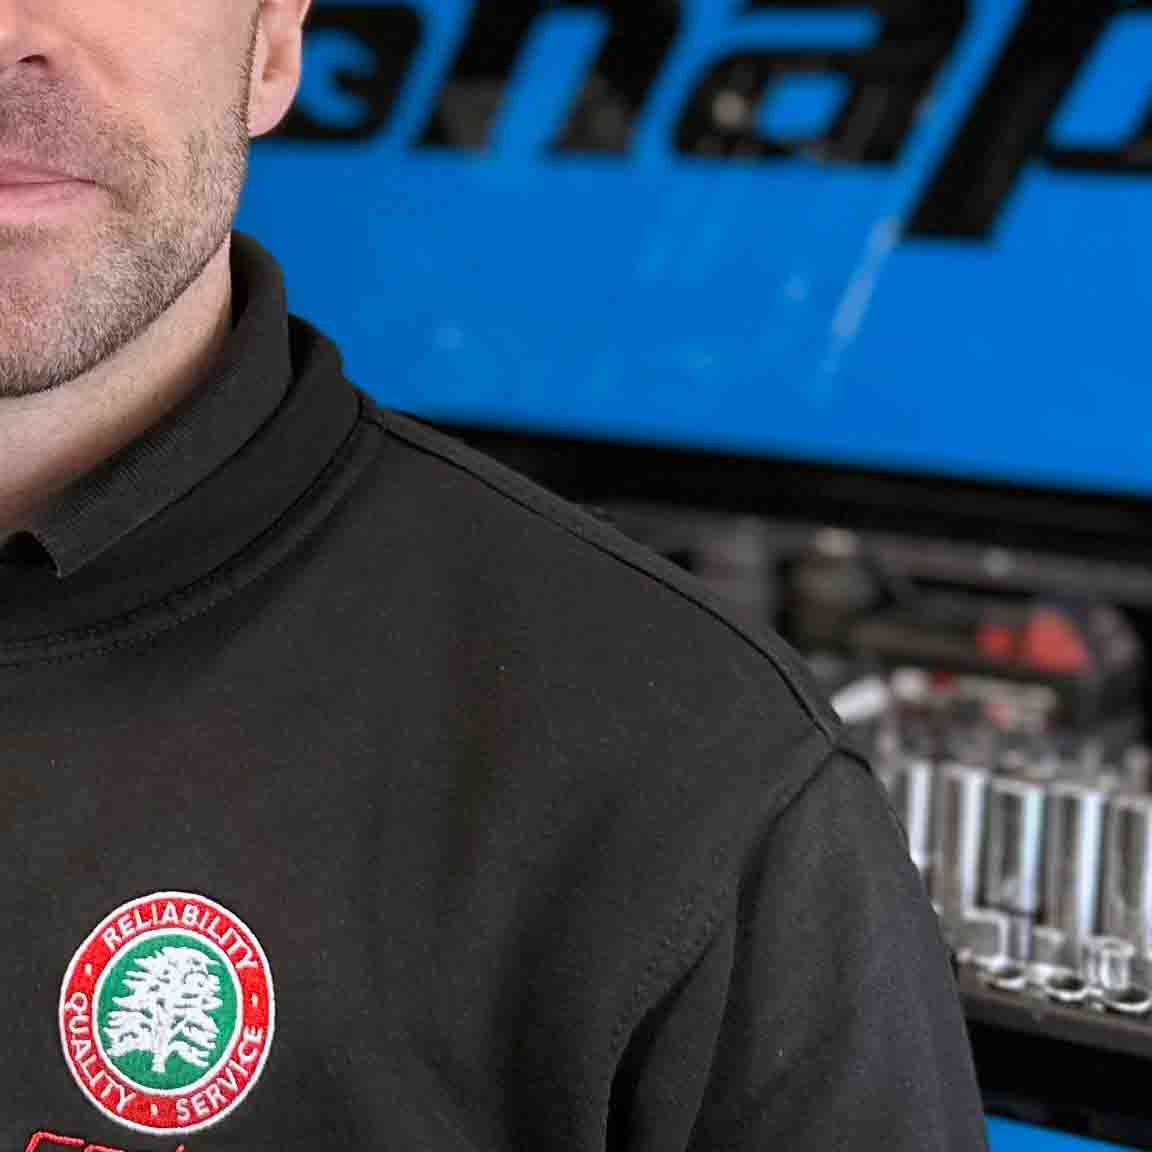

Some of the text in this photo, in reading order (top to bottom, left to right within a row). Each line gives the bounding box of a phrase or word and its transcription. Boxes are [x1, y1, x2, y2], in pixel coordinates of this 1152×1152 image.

[103, 903, 258, 970] RELIABILITY
[64, 992, 136, 1112] QUALITY
[176, 1025, 263, 1121] SERVICE
